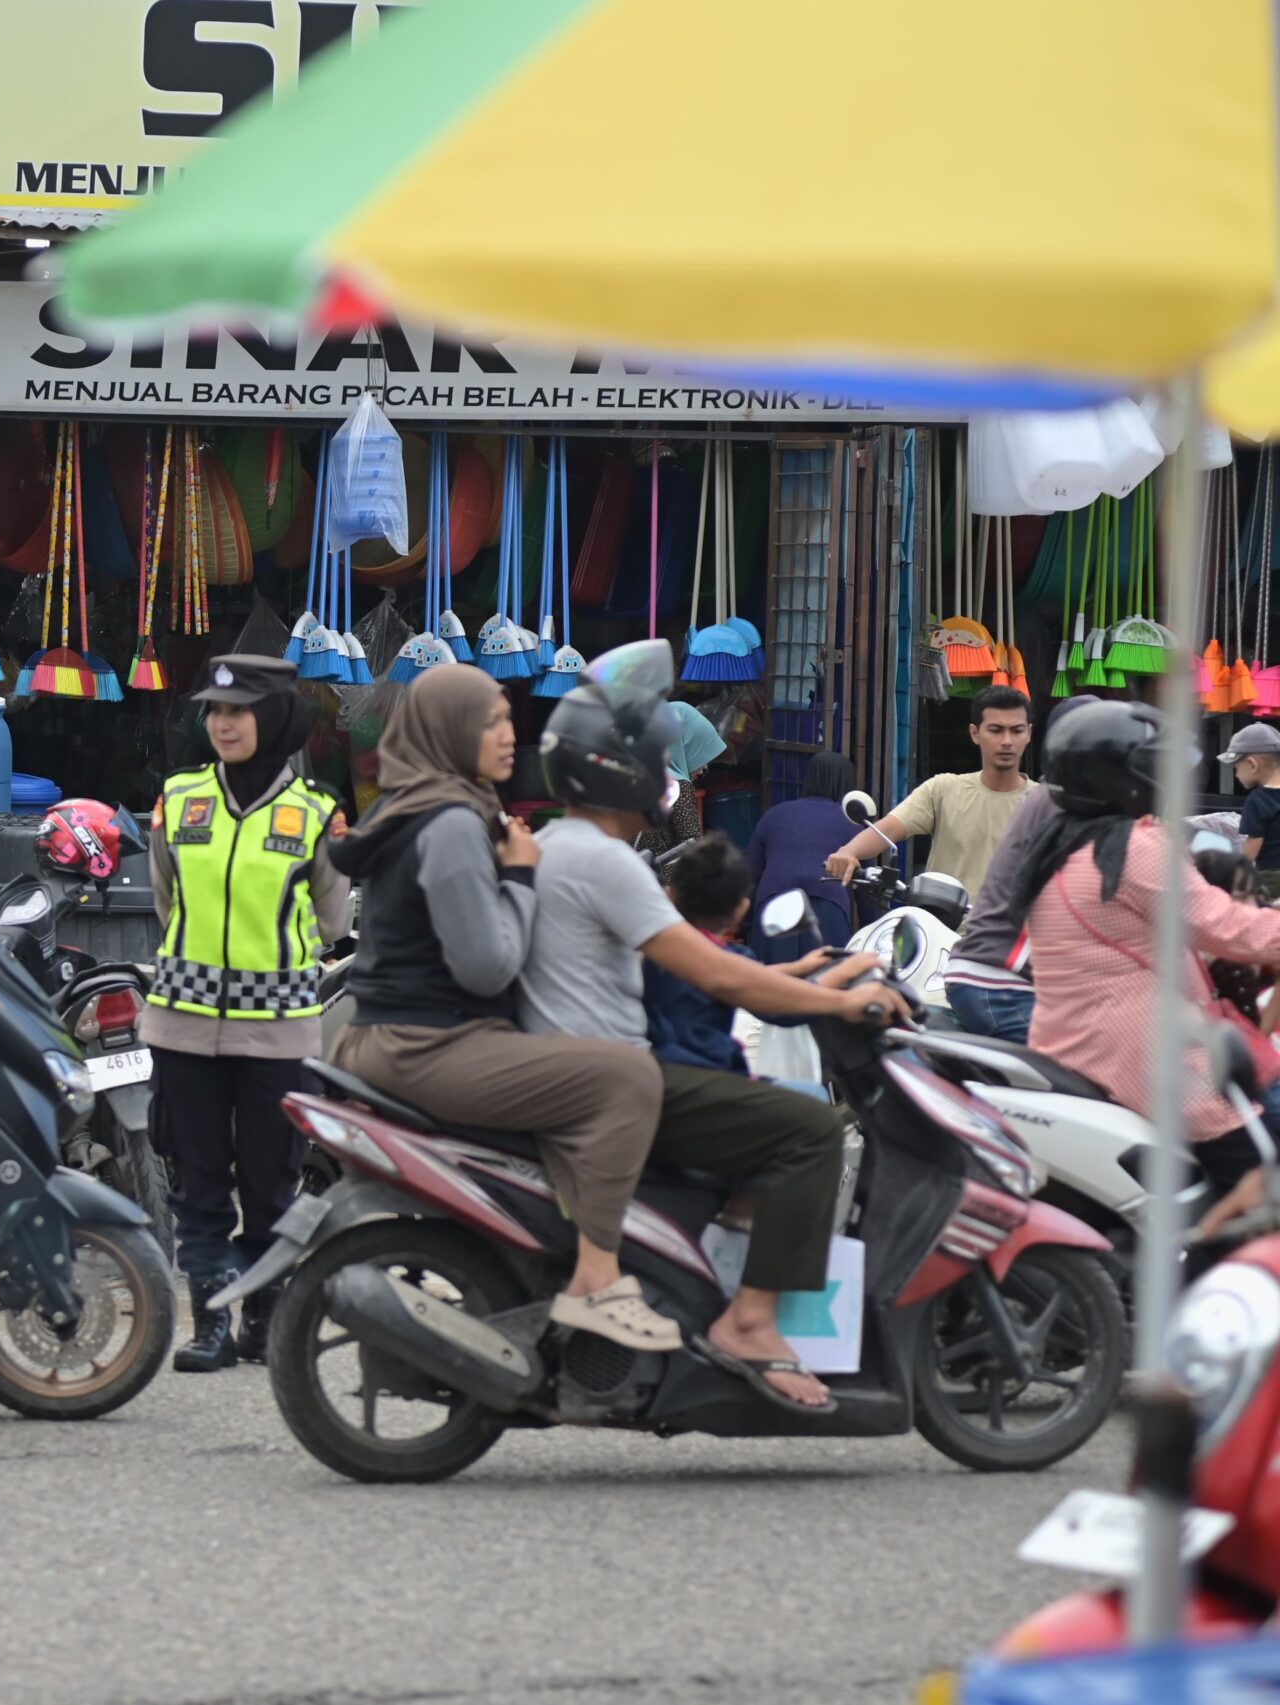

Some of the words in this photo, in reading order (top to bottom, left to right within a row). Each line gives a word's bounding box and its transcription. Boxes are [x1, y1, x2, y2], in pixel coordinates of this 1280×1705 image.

[24, 379, 184, 402] MENJUAL
[191, 382, 331, 406] BARANG
[341, 385, 454, 408] PECAH
[463, 387, 575, 409] BELAH
[596, 387, 801, 411] ELEKTRONIK
[107, 1052, 143, 1069] 4616
